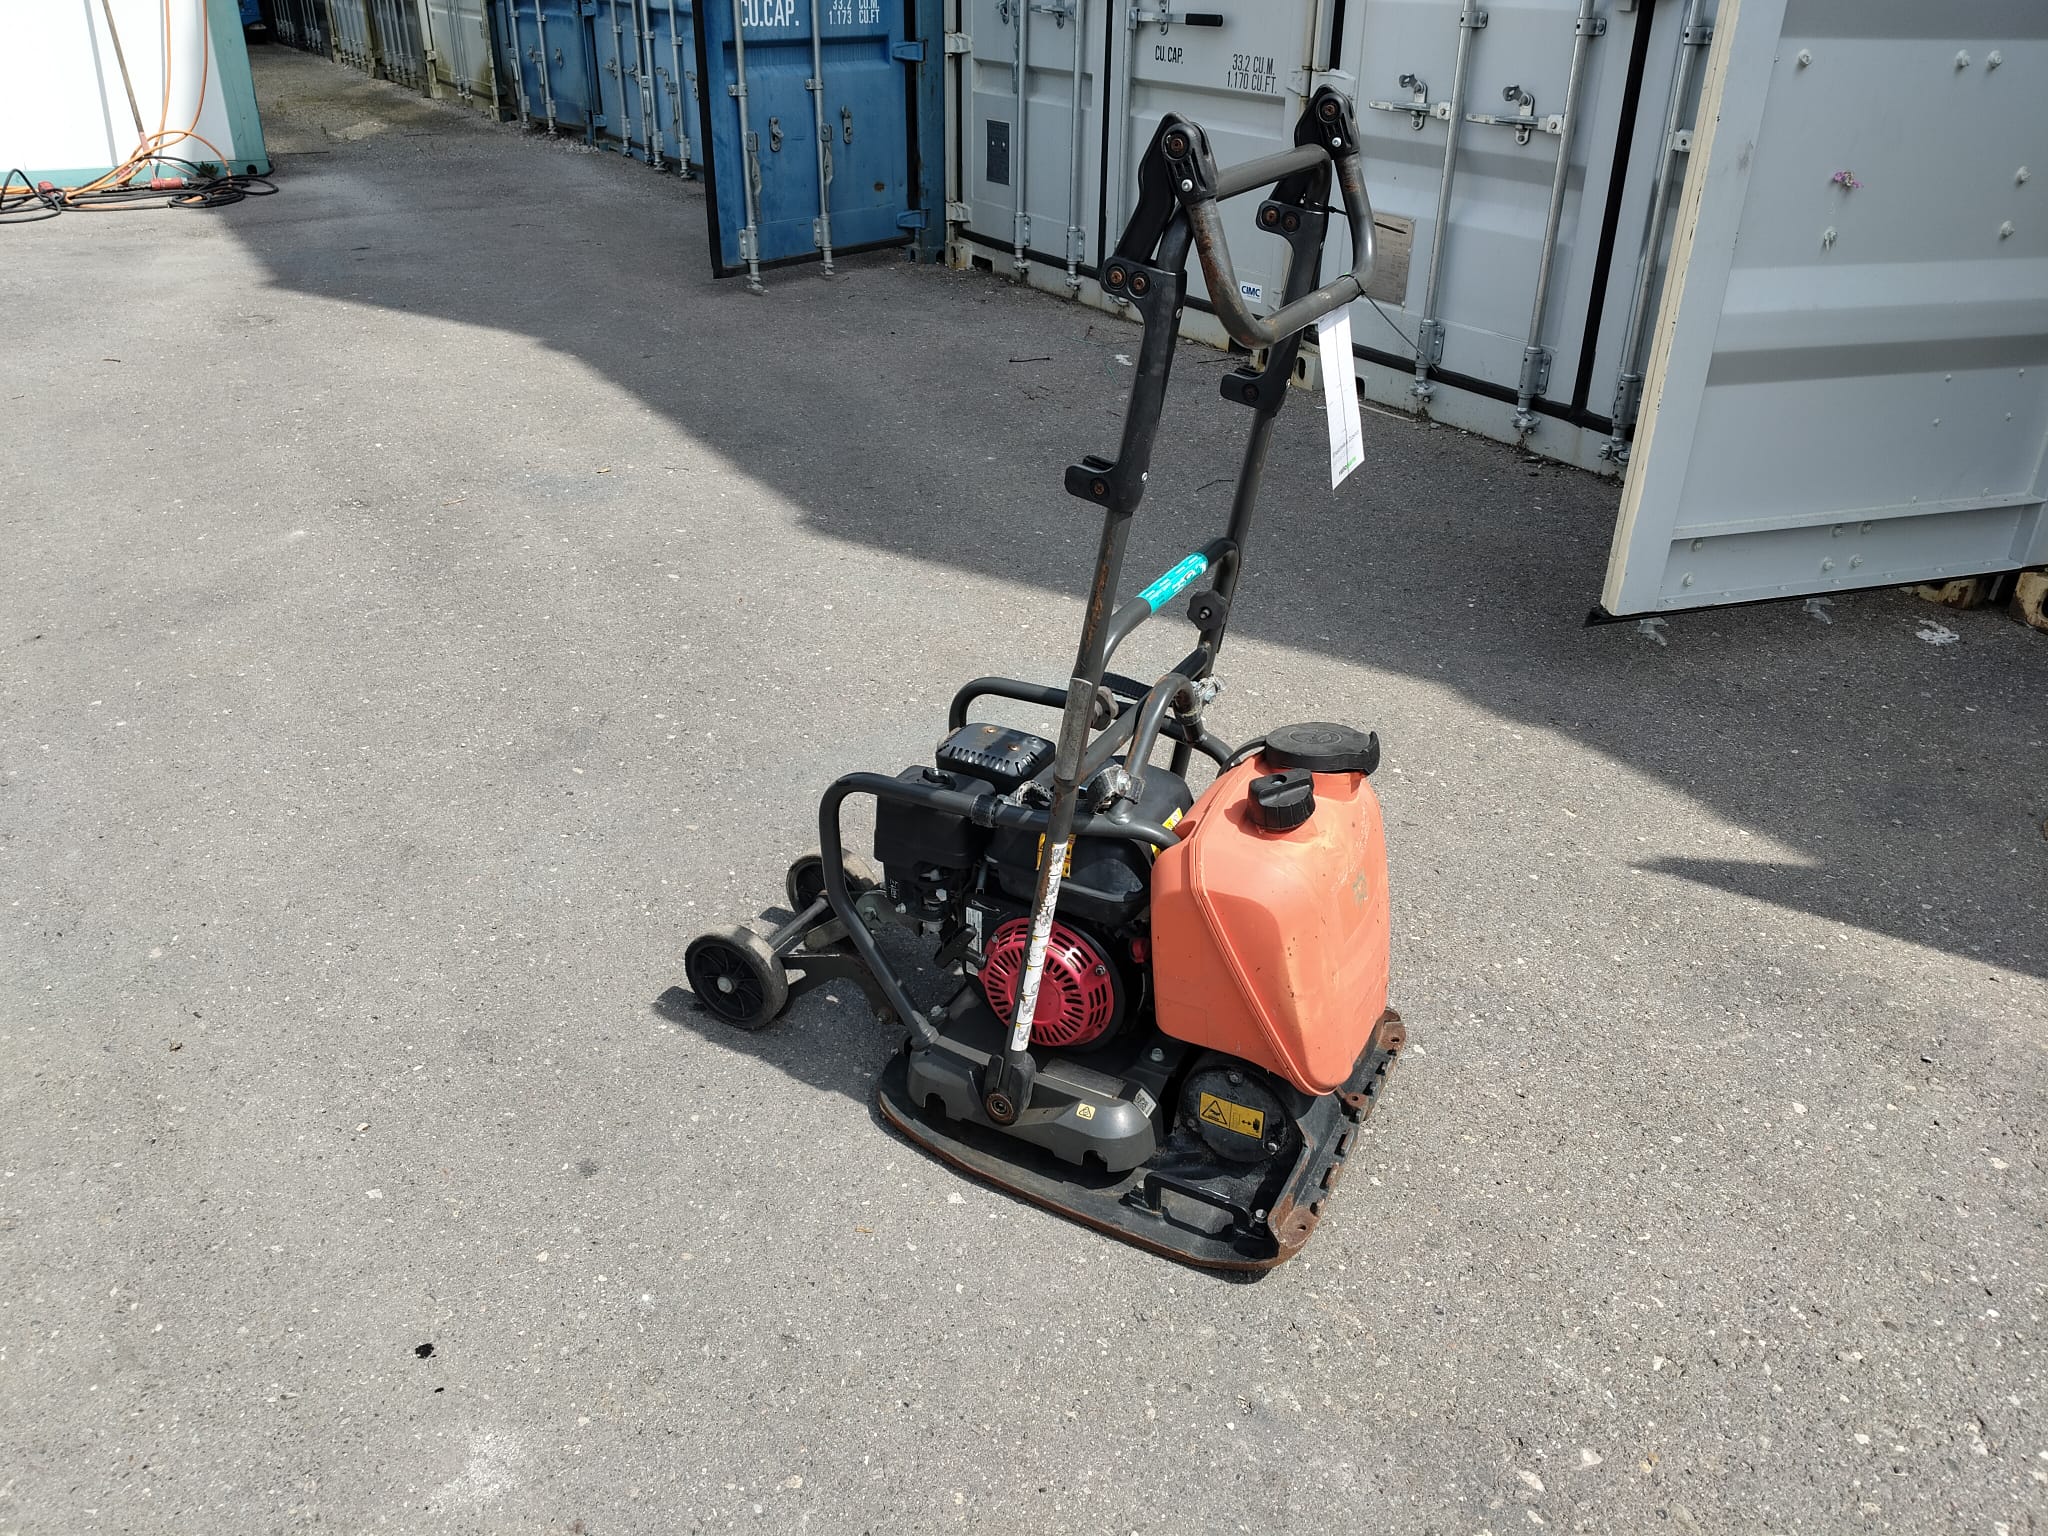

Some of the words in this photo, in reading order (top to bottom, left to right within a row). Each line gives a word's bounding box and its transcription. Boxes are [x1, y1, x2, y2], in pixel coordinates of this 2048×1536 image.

[828, 11, 852, 24] 1.173
[1232, 54, 1251, 72] 33.2
[1253, 56, 1275, 75] CU.M.
[1227, 71, 1249, 89] 1.170
[1251, 74, 1278, 94] CU.FT.
[1241, 285, 1261, 297] CIMC
